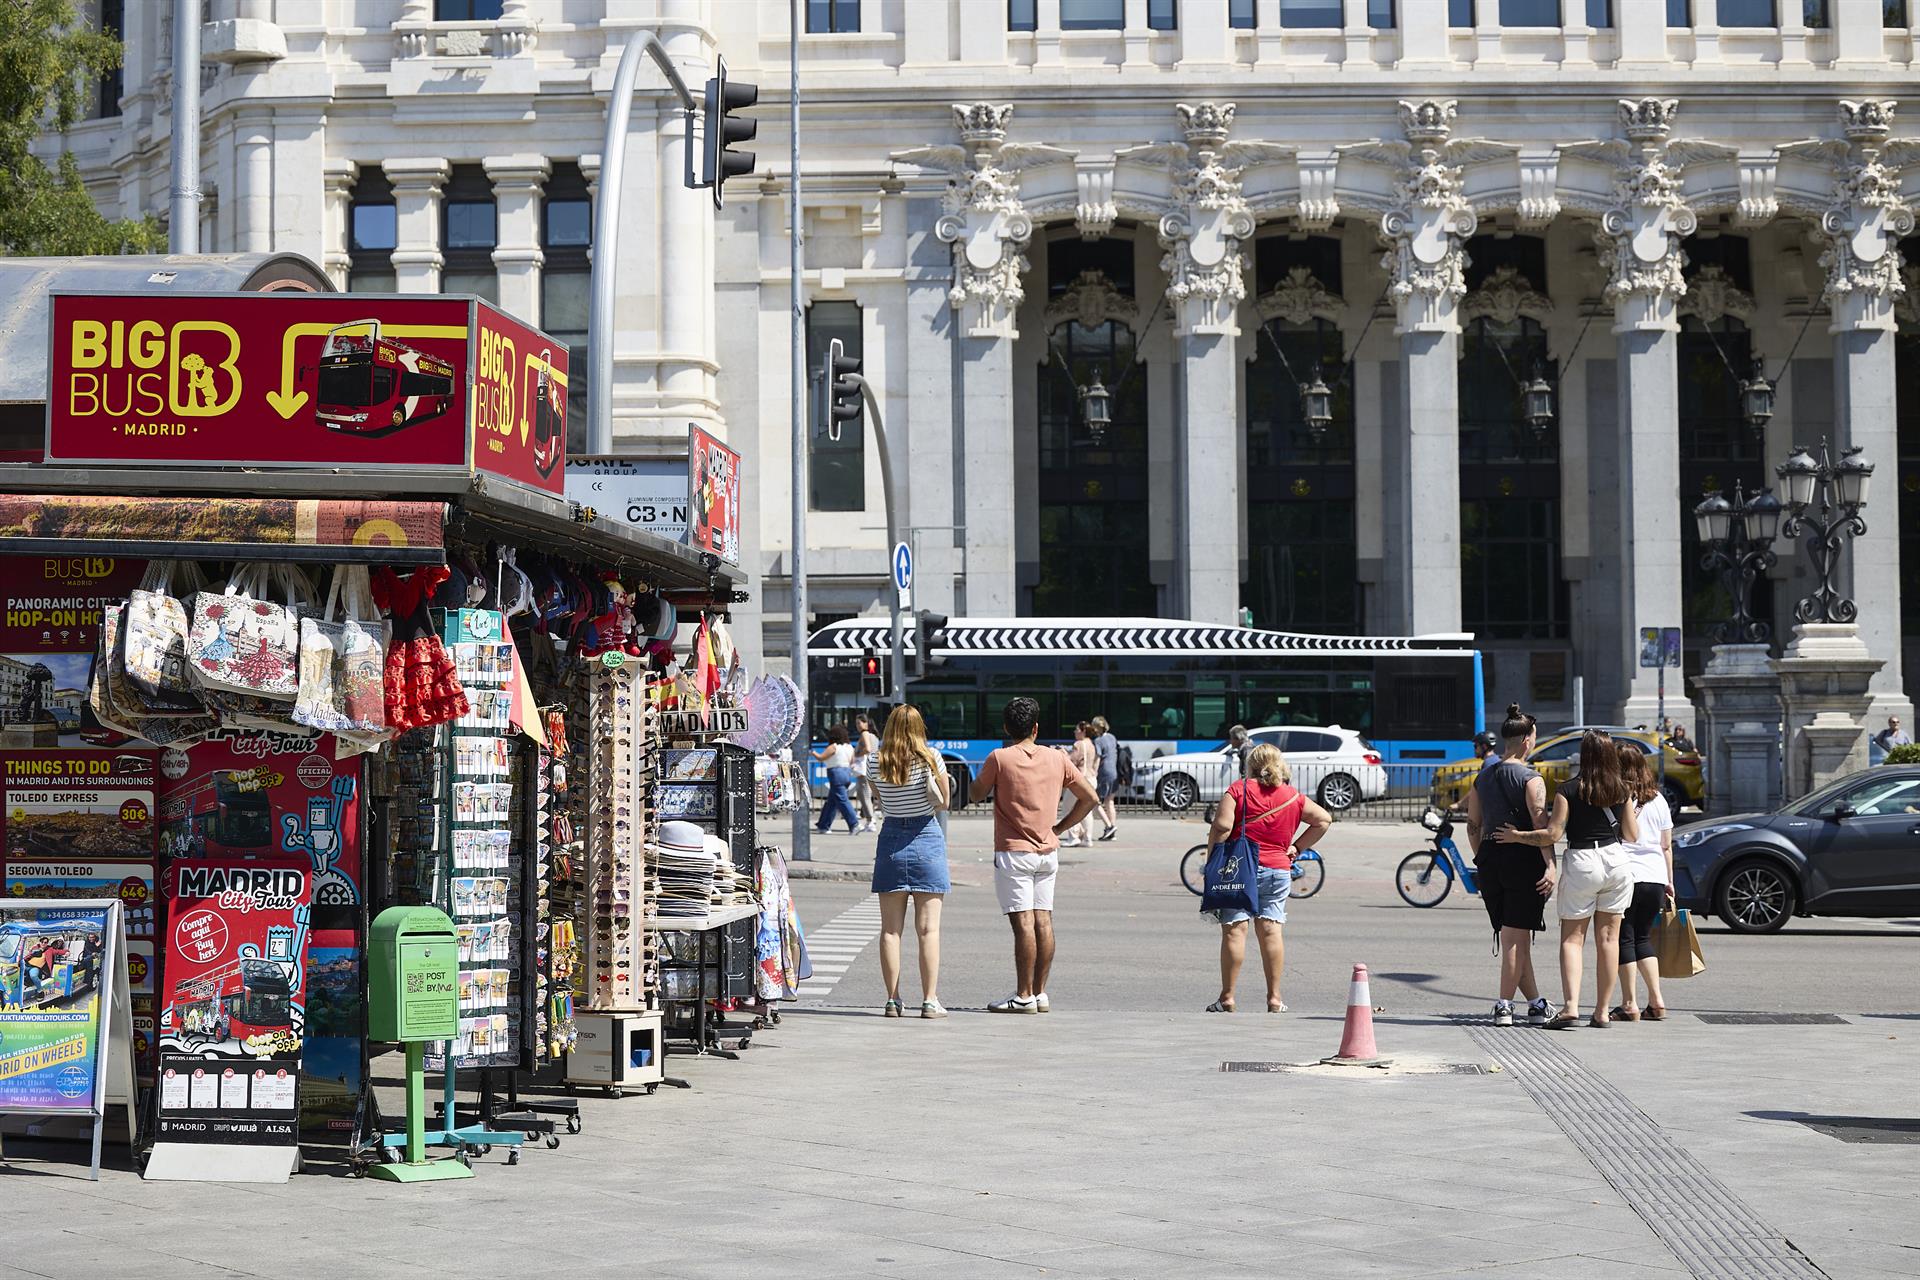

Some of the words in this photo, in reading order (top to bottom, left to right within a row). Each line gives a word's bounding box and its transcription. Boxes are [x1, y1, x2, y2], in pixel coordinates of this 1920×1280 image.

[72, 320, 165, 368] BIG
[480, 326, 501, 382] BIG
[70, 373, 164, 416] BUS
[479, 382, 499, 432] BUS
[124, 424, 186, 436] MADRID
[45, 560, 83, 578] BUS
[7, 598, 84, 610] PANORAMIC
[87, 598, 114, 609] CIT
[6, 611, 76, 627] HOP-ON
[271, 737, 317, 755] Tour
[947, 741, 968, 749] 5139
[5, 760, 62, 774] THINGS
[66, 761, 85, 774] TO
[90, 761, 110, 774] DO
[9, 794, 48, 802] TOLEDO
[53, 794, 98, 802] EXPRESS
[122, 809, 146, 820] 30€
[8, 867, 52, 876] SEGOVIA
[54, 867, 93, 876] TOLEDO
[180, 868, 304, 897] MADRID
[121, 886, 145, 898] 64€
[219, 890, 254, 913] City
[254, 890, 296, 909] Tour
[182, 914, 213, 932] Compre
[191, 924, 210, 939] aquí
[195, 938, 214, 952] Buy
[199, 948, 217, 961] here
[13, 1042, 53, 1056] HISTORICAL
[56, 1037, 70, 1045] AND
[24, 1054, 38, 1068] ON
[42, 1041, 83, 1064] WHEELS
